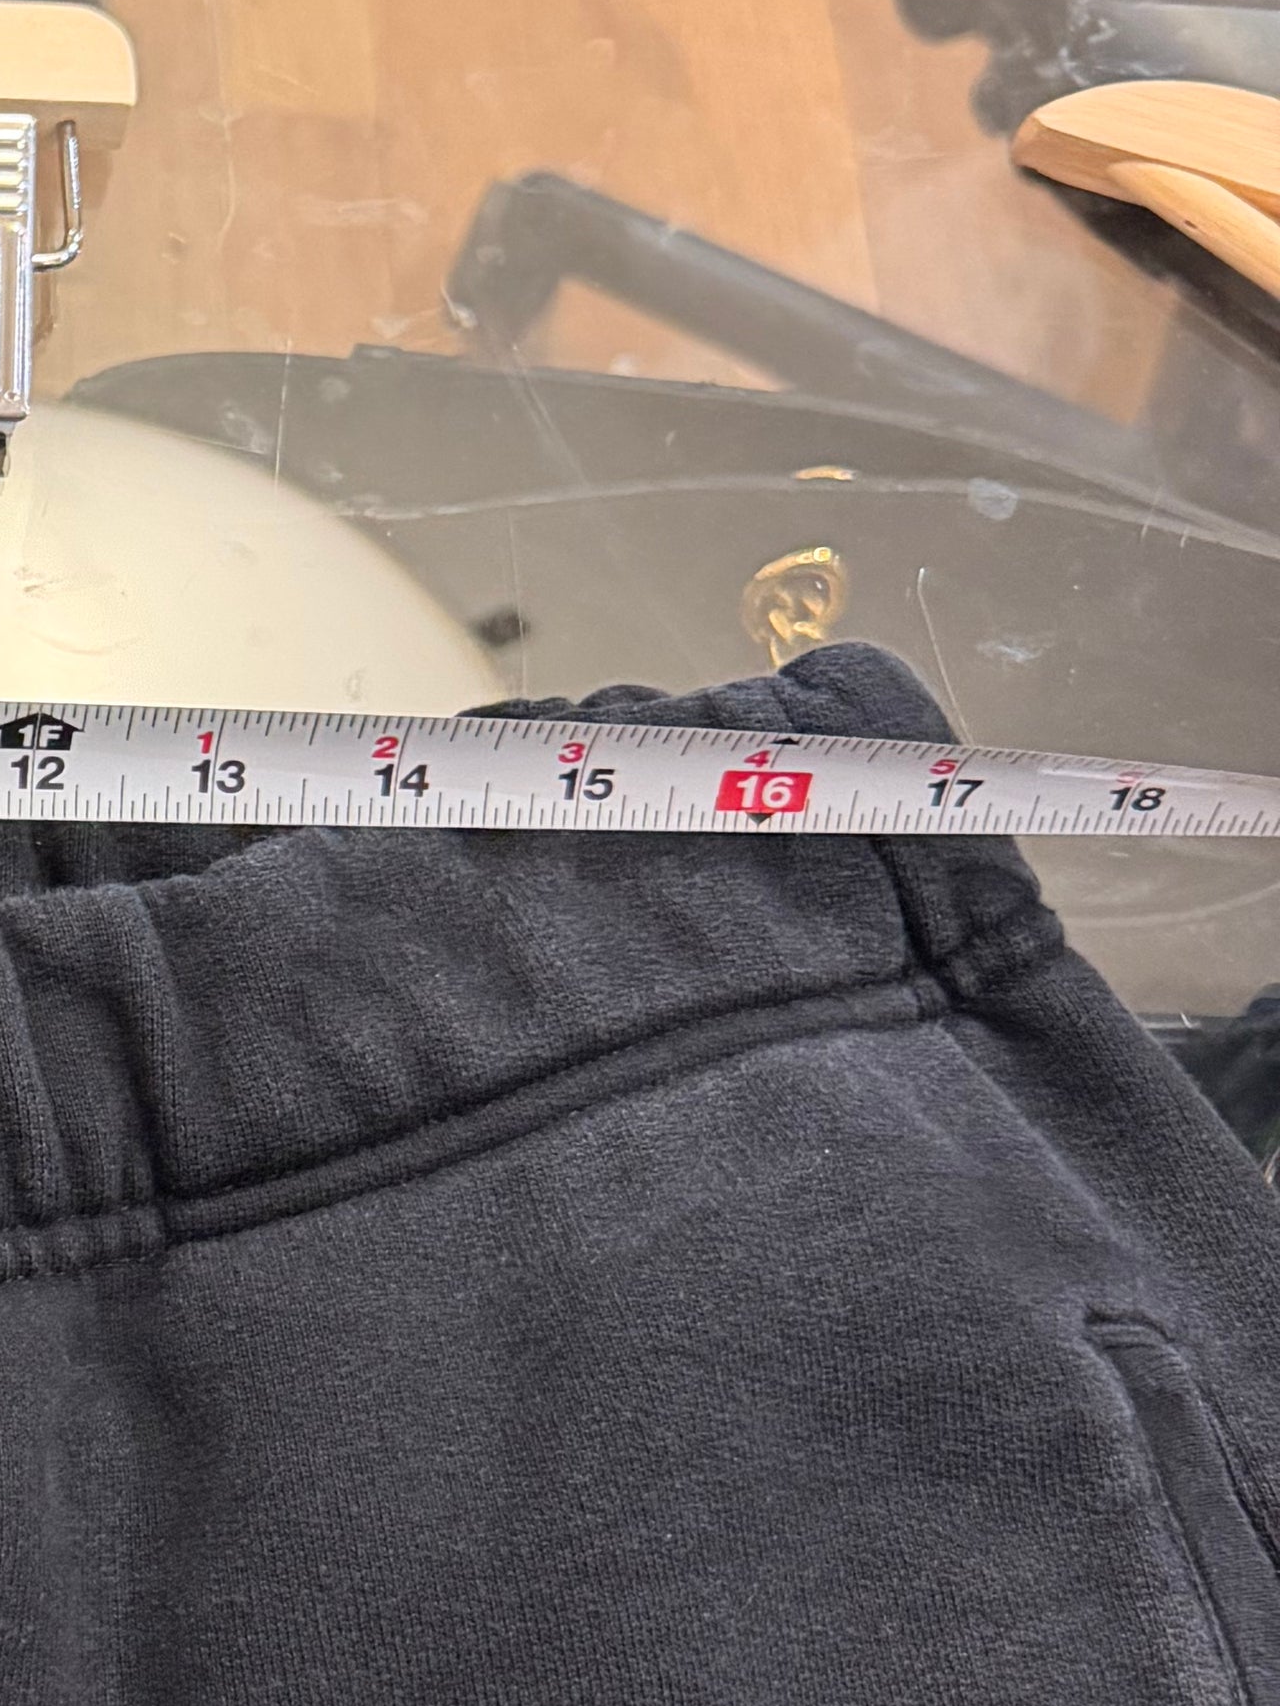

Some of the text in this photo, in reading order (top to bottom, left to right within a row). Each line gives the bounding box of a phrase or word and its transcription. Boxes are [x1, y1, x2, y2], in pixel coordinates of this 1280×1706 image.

[18, 724, 63, 748] 1F
[196, 731, 214, 754] 1
[372, 736, 399, 759] 2
[558, 742, 585, 764] 3
[744, 750, 771, 768] 4
[929, 759, 959, 776] 5
[10, 755, 65, 790] 12
[191, 759, 246, 794] 13
[374, 763, 429, 798] 14
[558, 767, 616, 801] 15
[736, 775, 795, 809] 16
[927, 779, 985, 807] 17
[1109, 786, 1166, 811] 18
